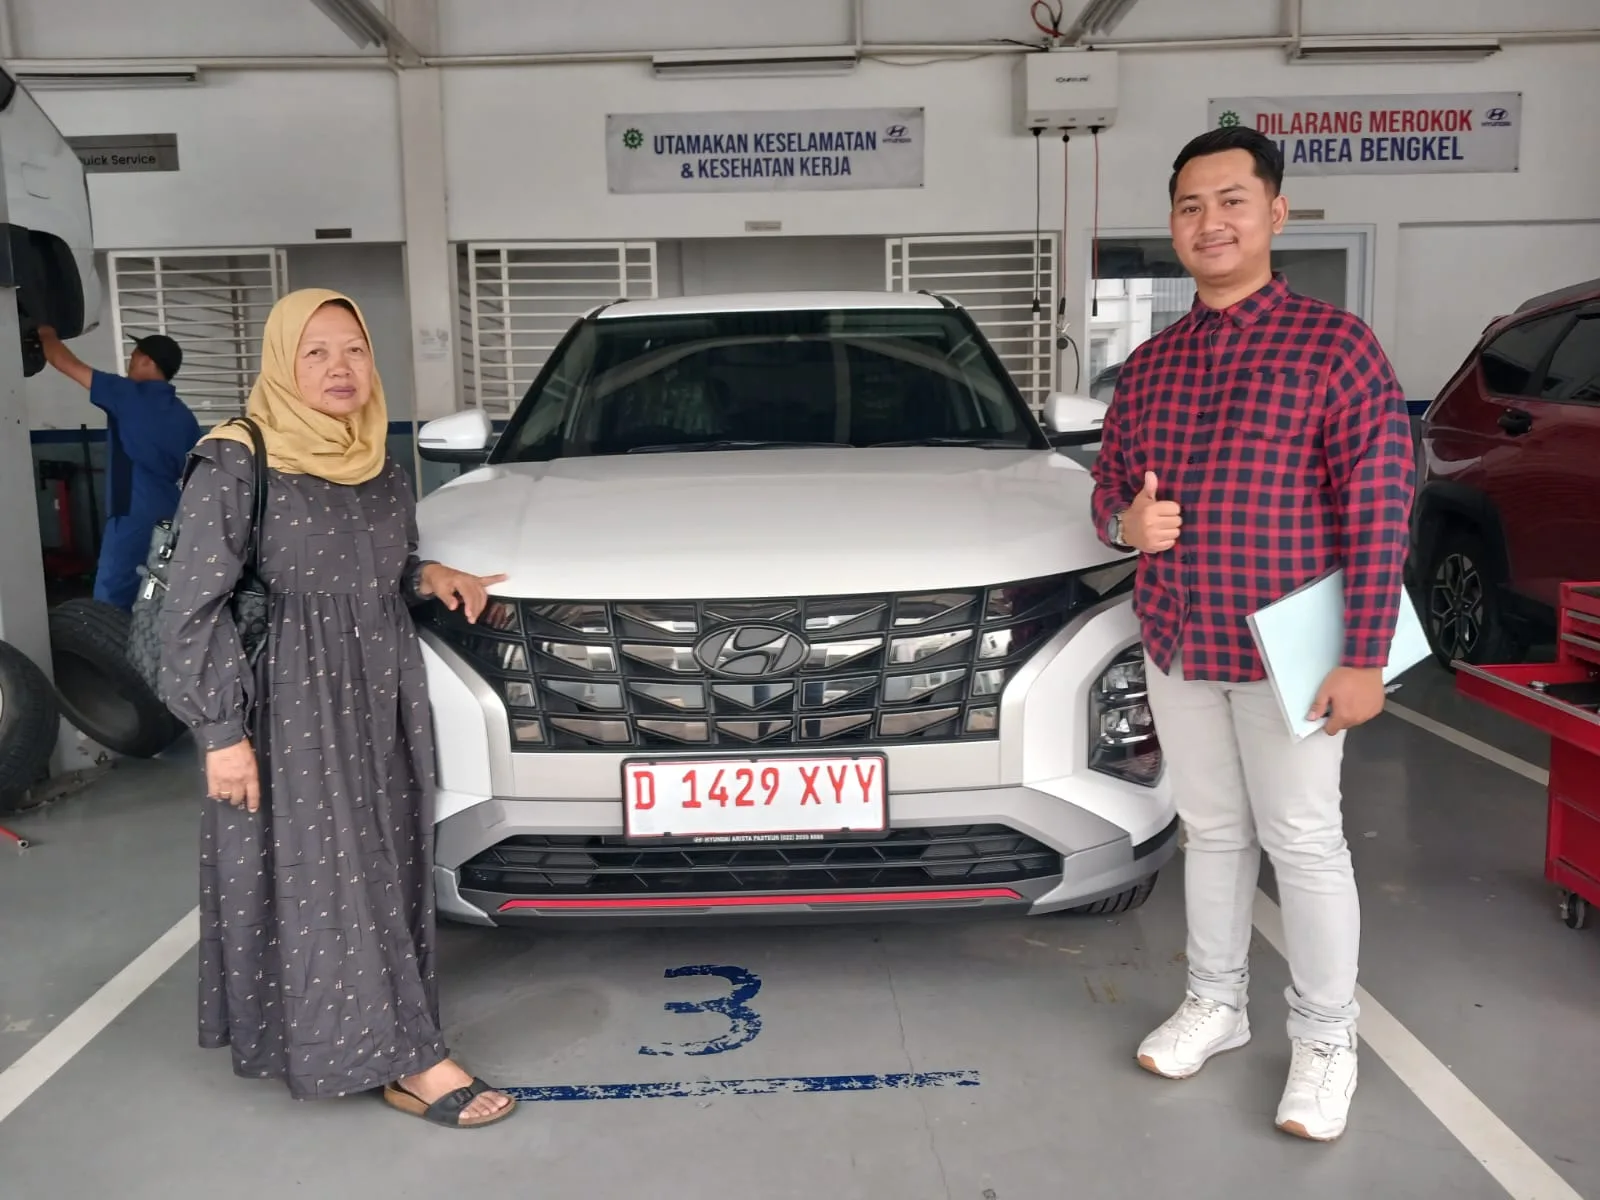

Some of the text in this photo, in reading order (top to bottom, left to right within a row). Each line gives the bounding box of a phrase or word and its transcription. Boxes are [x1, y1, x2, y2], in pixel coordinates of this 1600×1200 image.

[1256, 109, 1472, 135] DILARANG MEROKOK
[653, 131, 876, 155] UTAMAKAN KESELAMATAN
[1292, 137, 1353, 163] AREA
[1360, 136, 1464, 162] BENGKEL
[80, 154, 156, 166] uick Service
[681, 156, 851, 178] & KESEHATAN KERJA
[633, 765, 876, 810] D 1429 XYY
[638, 965, 761, 1056] 3
